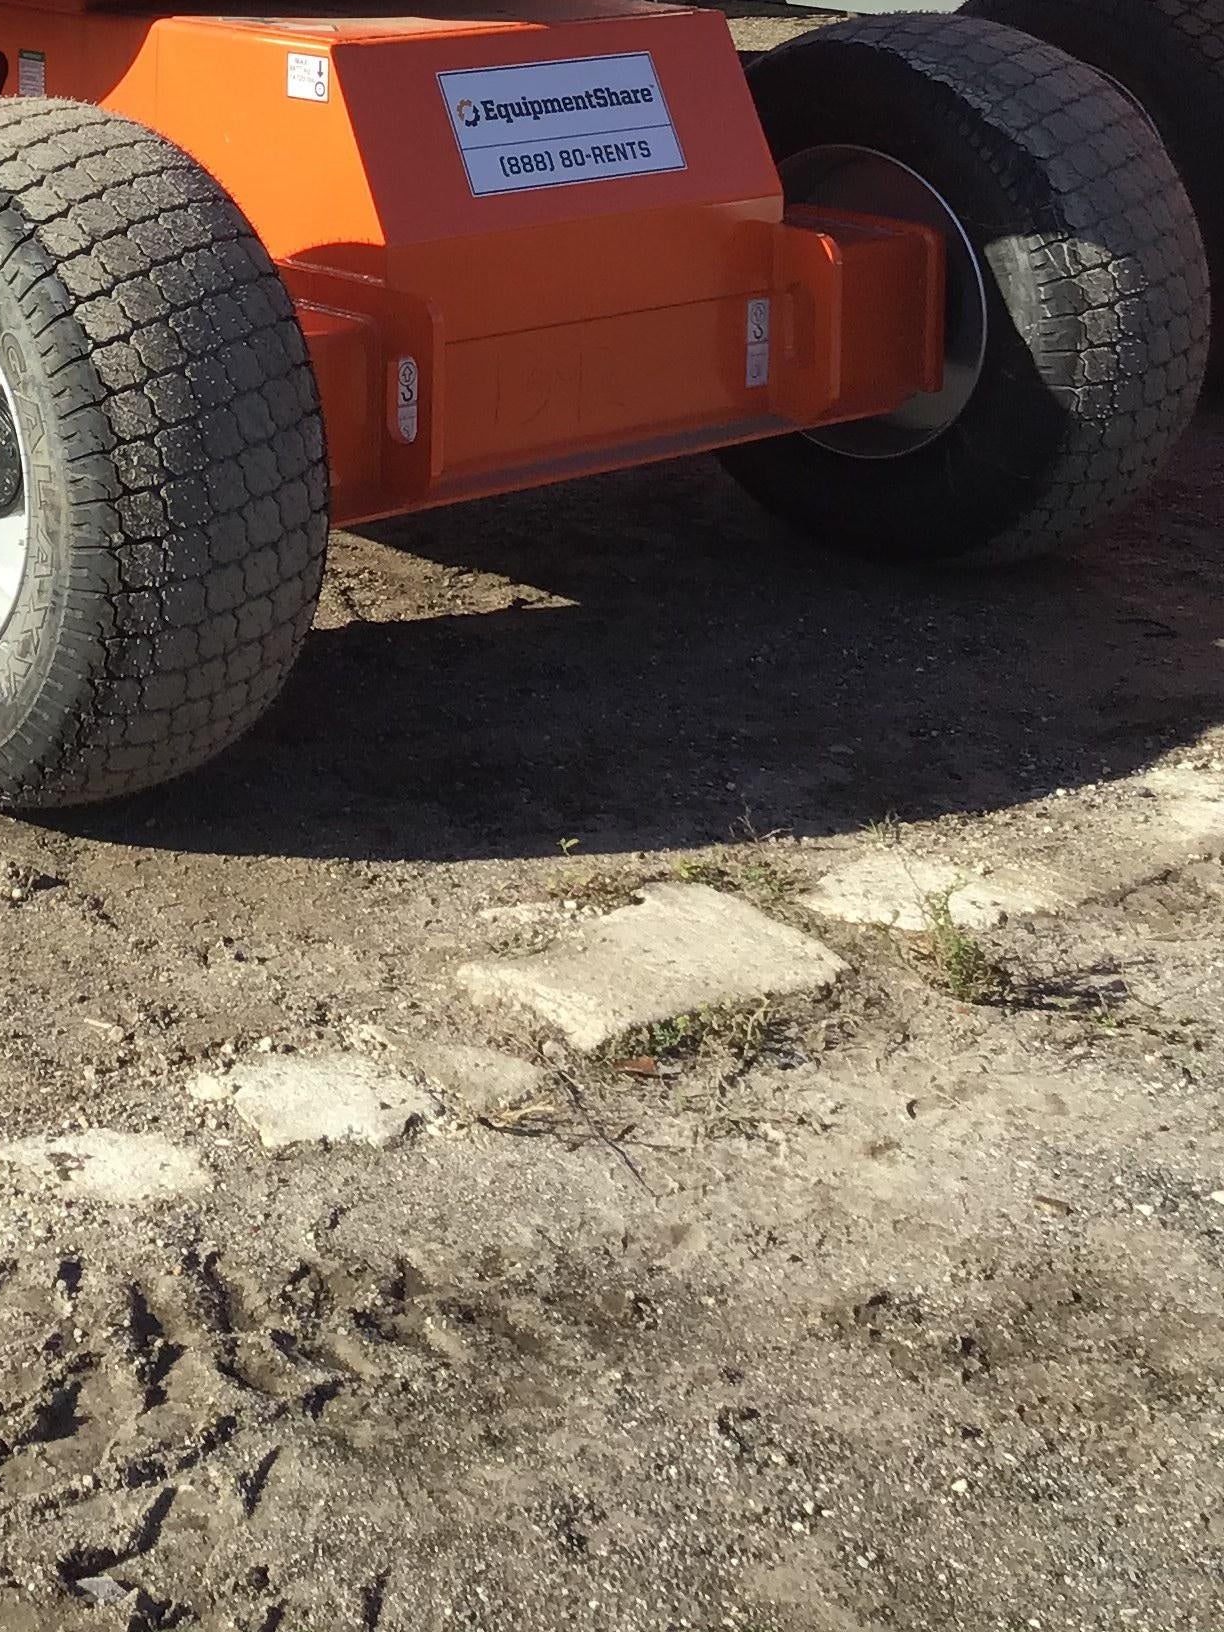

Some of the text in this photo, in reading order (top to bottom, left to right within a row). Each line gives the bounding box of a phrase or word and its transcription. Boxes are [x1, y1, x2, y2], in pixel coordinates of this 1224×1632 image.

[480, 85, 655, 125] EquipmentShare
[499, 139, 652, 178] (888) 80-RENTS
[1, 332, 53, 700] GALAXY
